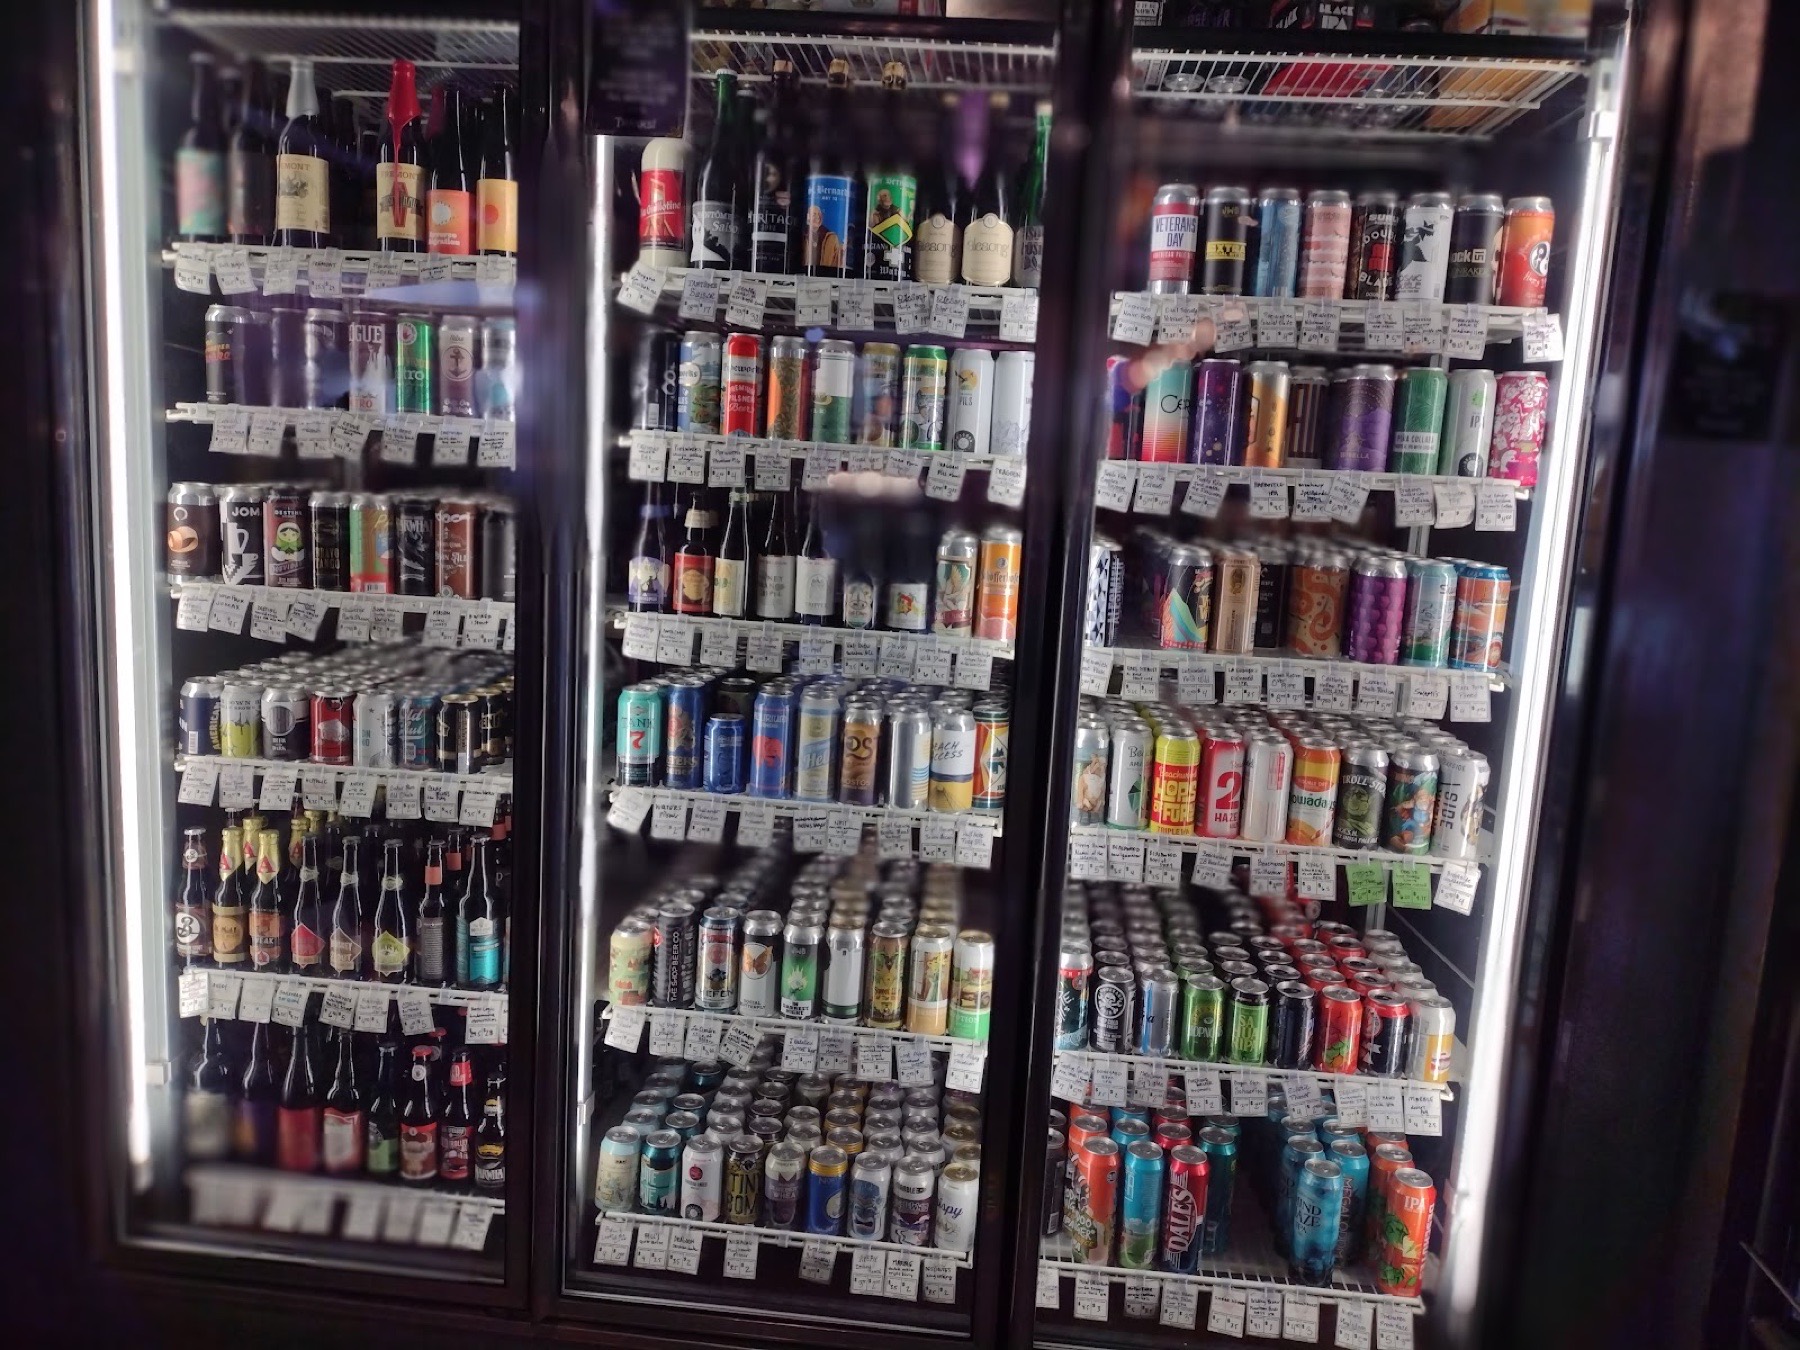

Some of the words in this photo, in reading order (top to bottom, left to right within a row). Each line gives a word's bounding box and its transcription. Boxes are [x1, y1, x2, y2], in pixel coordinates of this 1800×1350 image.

[1319, 4, 1354, 16] BLACK
[1322, 15, 1348, 30] IPA
[1155, 215, 1197, 233] VETERANS
[1166, 233, 1184, 247] DAY
[231, 506, 261, 517] JOM
[629, 730, 645, 749] 7
[1159, 765, 1197, 778] Beachwood
[1216, 771, 1242, 810] 2
[1404, 1196, 1426, 1212] IPA
